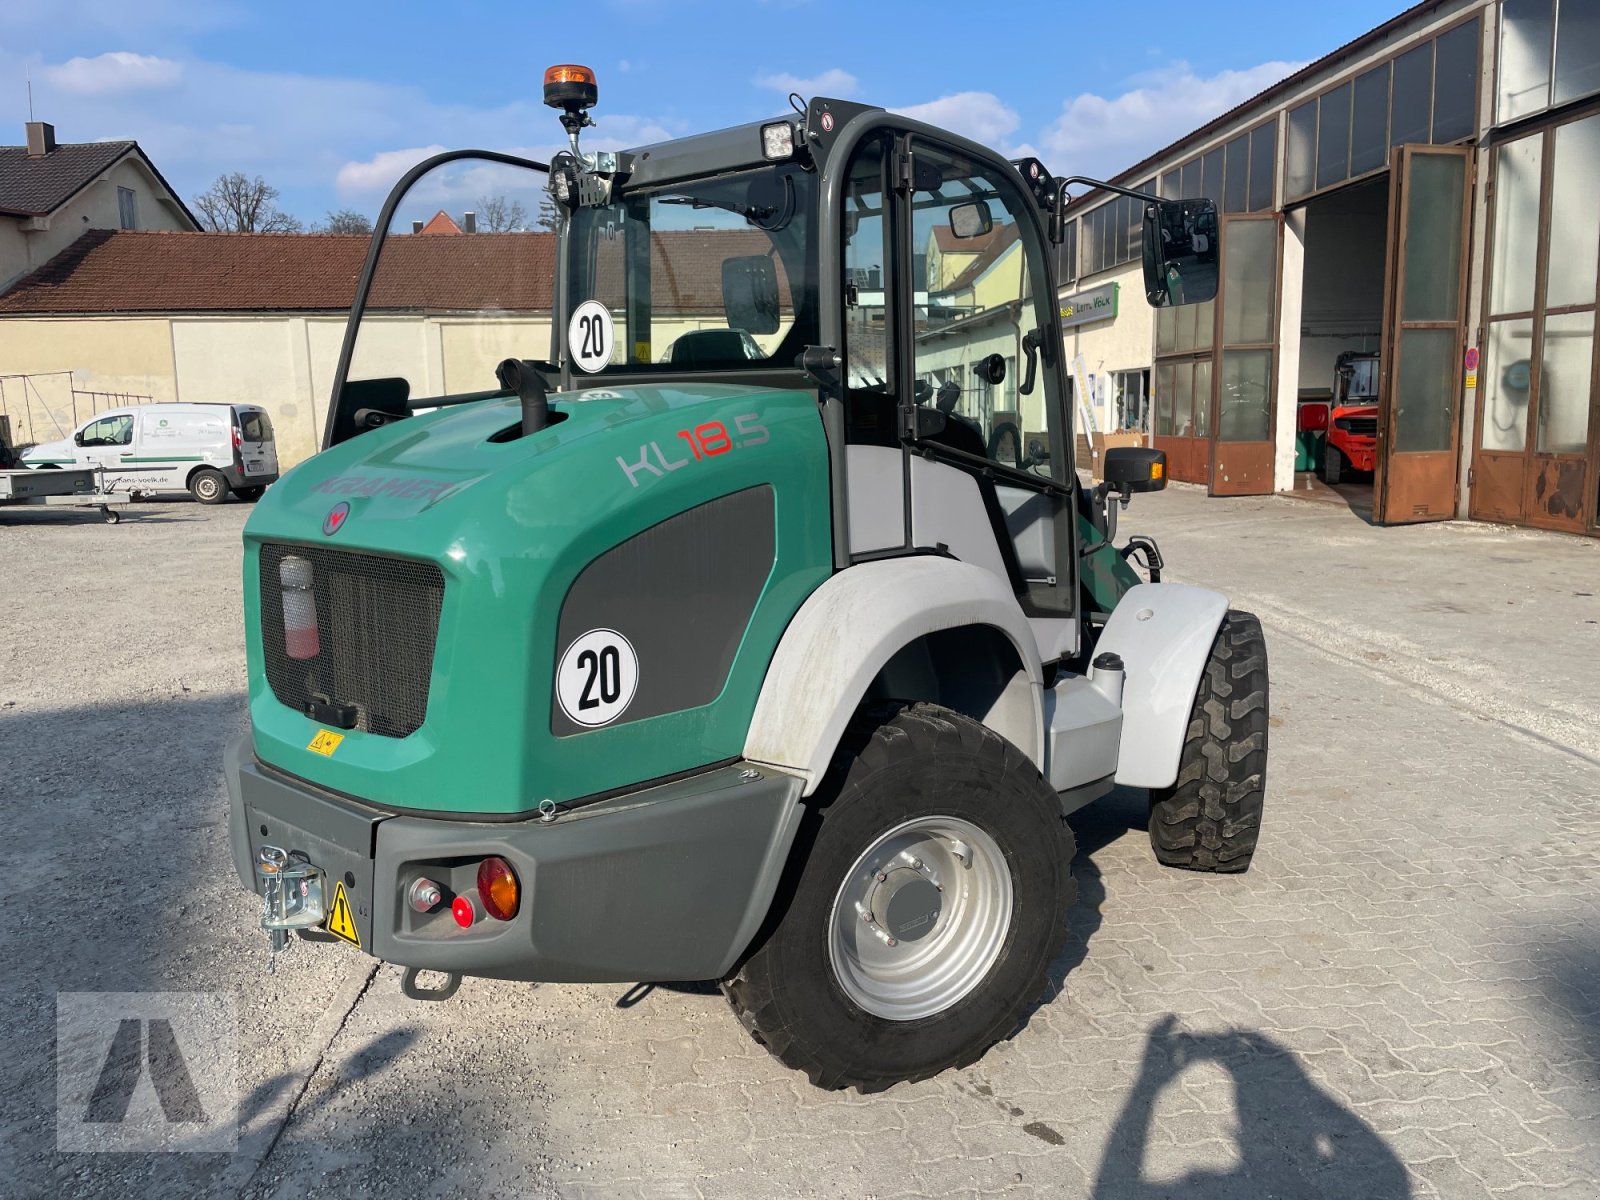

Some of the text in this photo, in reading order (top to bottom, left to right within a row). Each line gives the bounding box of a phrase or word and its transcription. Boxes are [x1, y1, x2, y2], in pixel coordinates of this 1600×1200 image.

[579, 313, 604, 359] 20
[615, 412, 770, 488] KL18.5
[577, 645, 621, 711] 20
